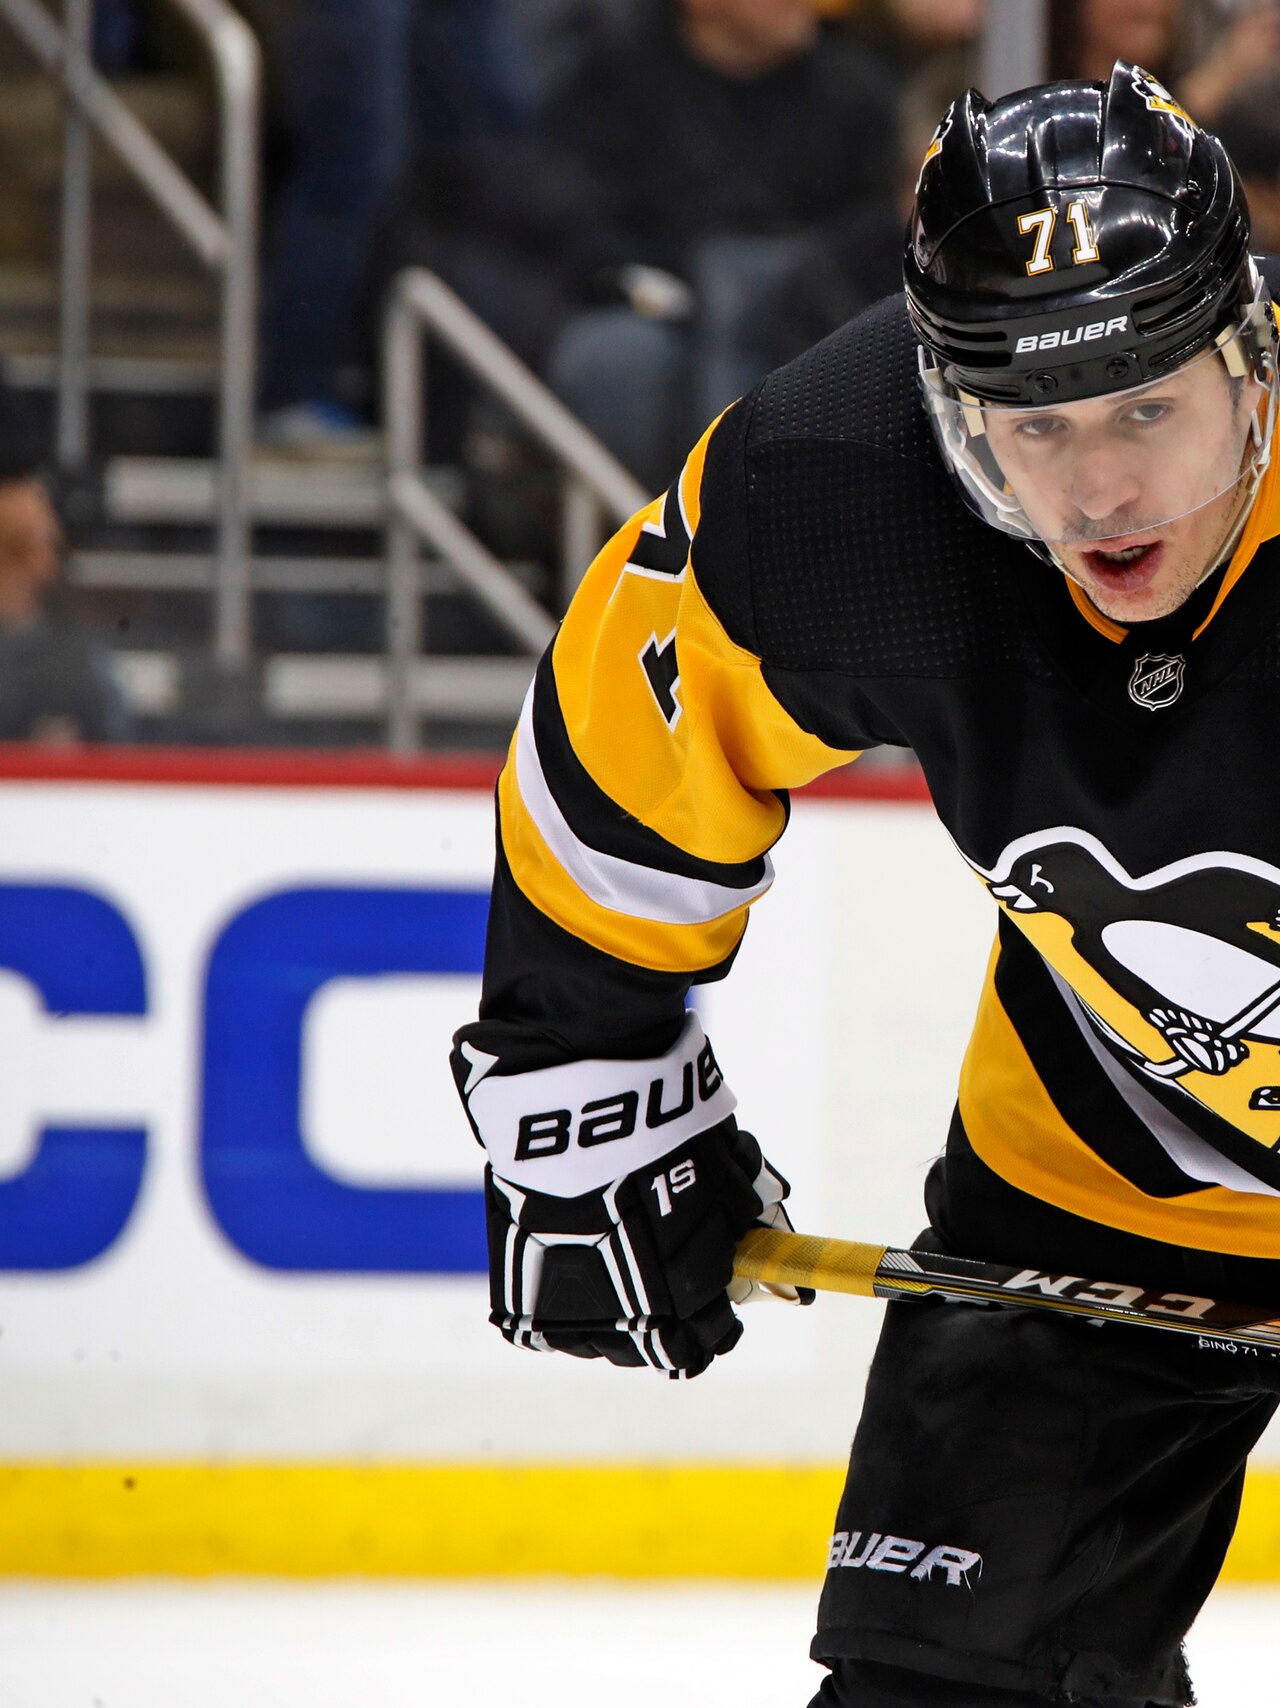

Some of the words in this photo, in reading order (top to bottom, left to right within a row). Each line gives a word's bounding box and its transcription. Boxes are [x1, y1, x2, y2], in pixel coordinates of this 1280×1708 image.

[1017, 201, 1100, 277] 71
[1140, 666, 1175, 695] NHL
[514, 1033, 724, 1162] BAUE
[1001, 1269, 1217, 1320] CCM
[1242, 1346, 1258, 1357] 71
[826, 1531, 981, 1586] AUER
